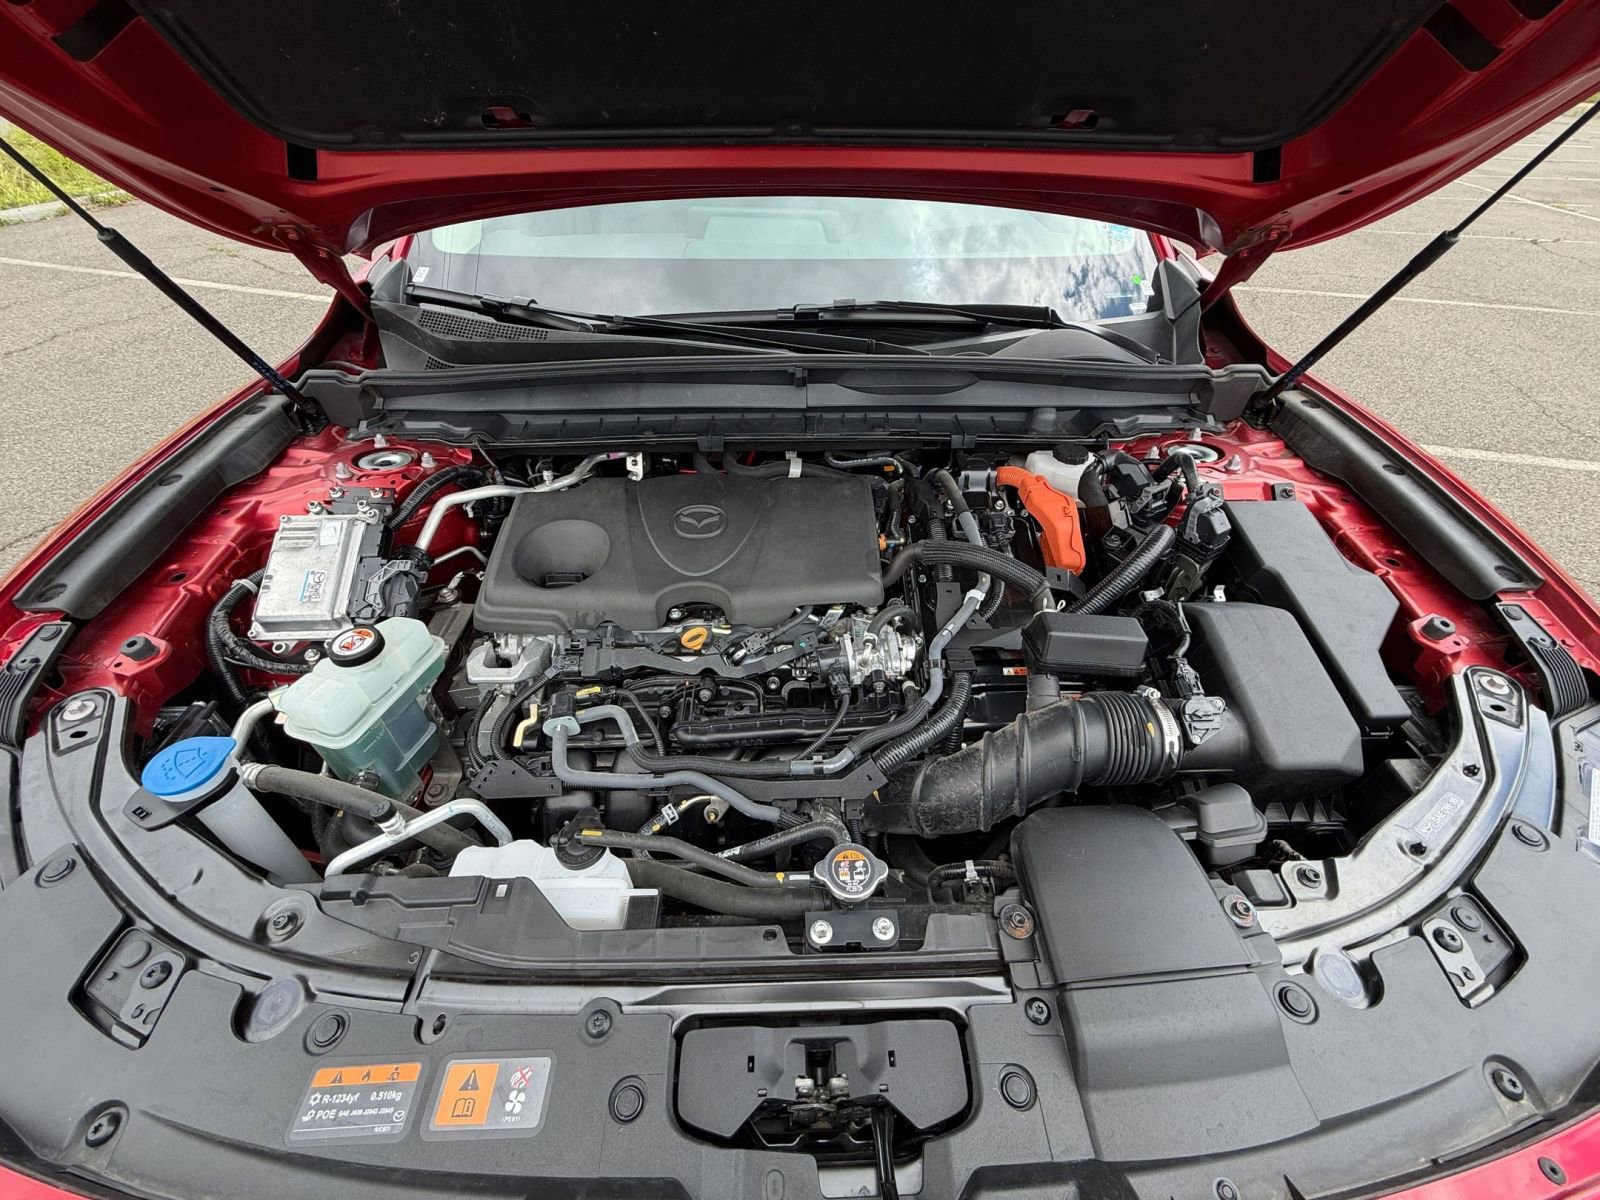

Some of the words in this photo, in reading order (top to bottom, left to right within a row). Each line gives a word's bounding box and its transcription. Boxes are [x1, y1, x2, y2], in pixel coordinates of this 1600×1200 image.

[321, 1092, 360, 1104] R-1234yf
[370, 1091, 403, 1102] 0.510kg
[315, 1109, 337, 1120] POE
